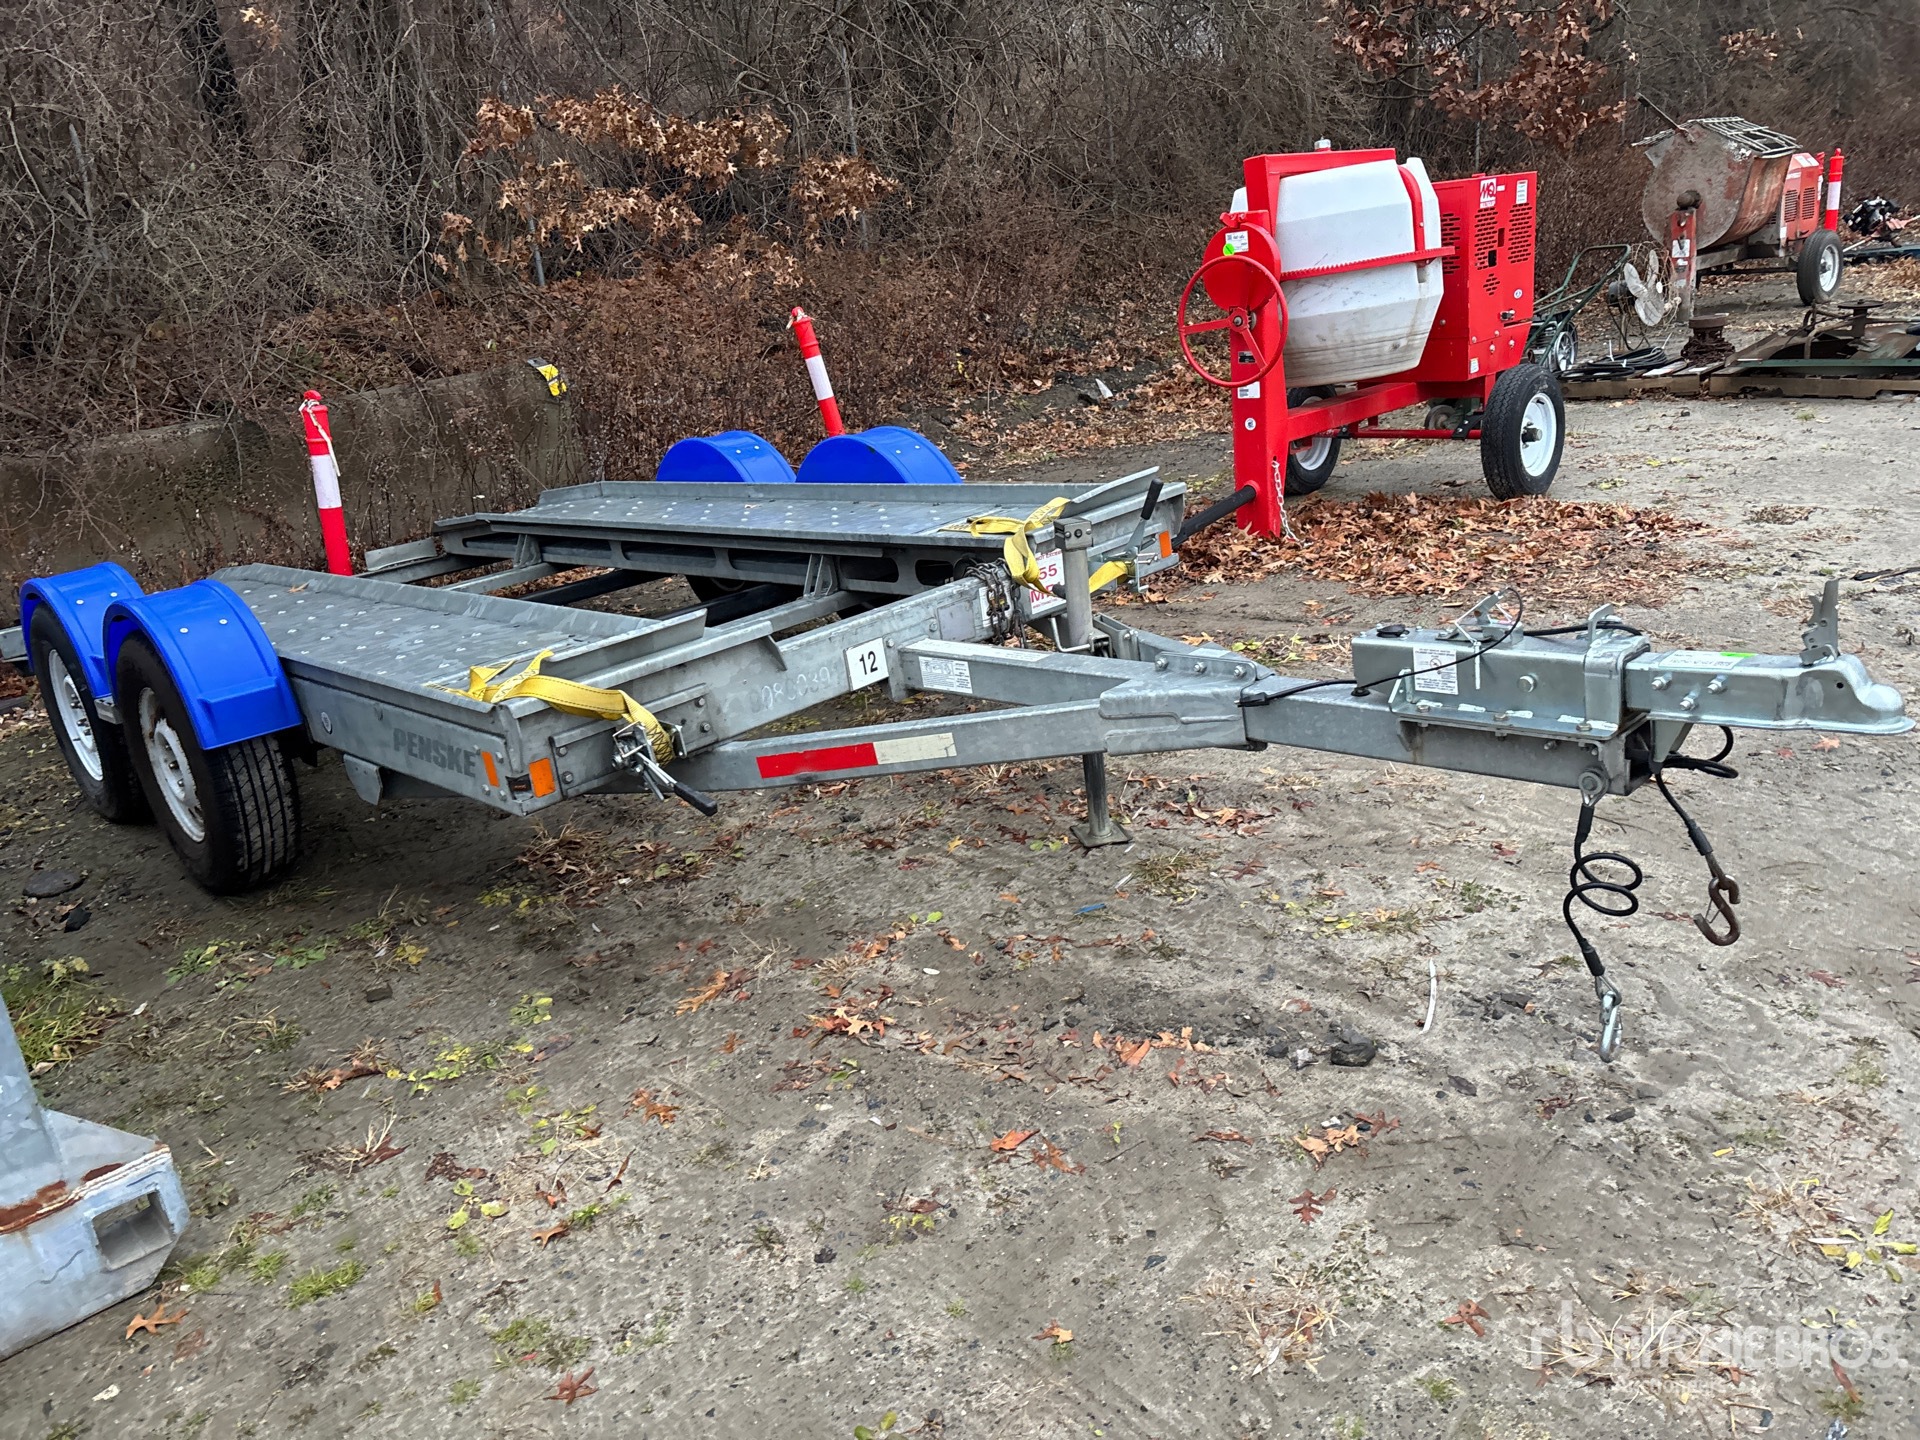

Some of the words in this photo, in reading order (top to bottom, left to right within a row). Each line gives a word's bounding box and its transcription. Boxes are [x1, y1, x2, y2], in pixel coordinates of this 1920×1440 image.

[1039, 563, 1058, 580] 55
[859, 650, 878, 675] 12
[393, 728, 476, 778] PENSKE
